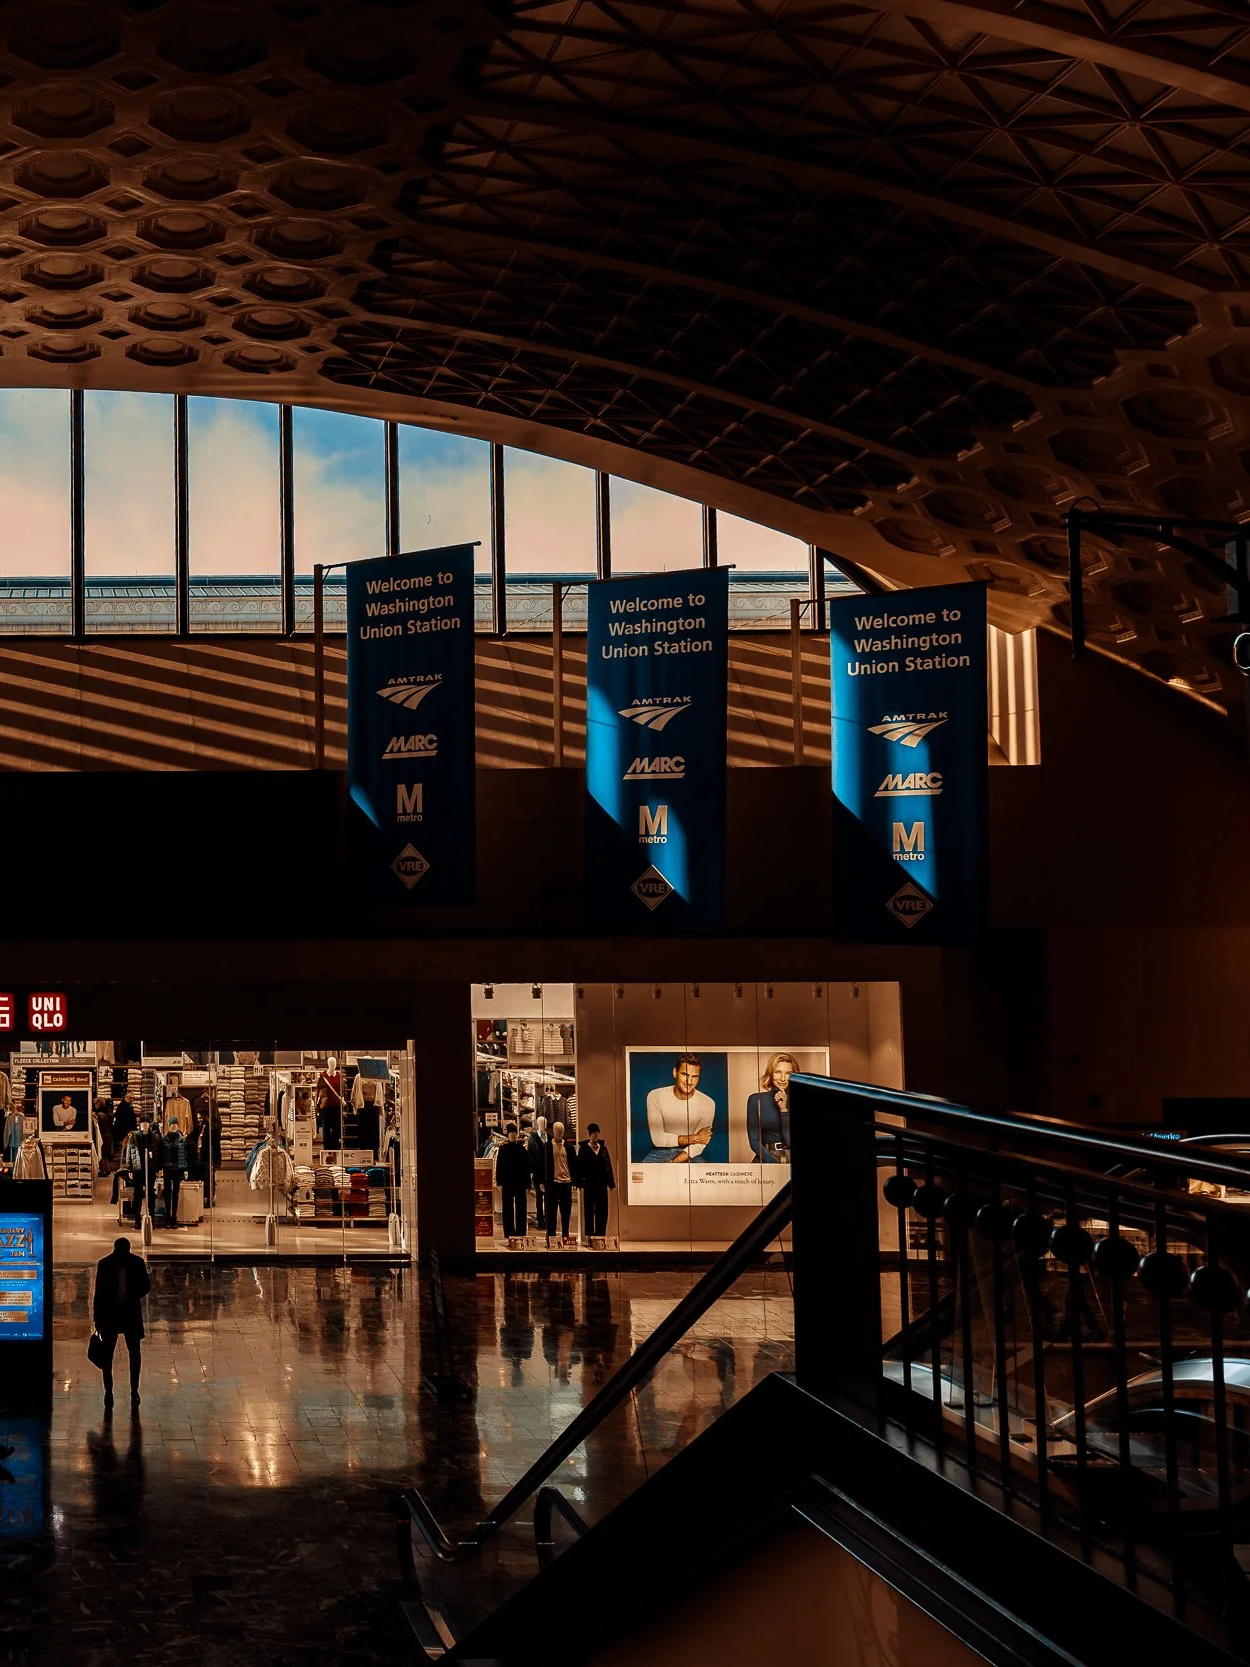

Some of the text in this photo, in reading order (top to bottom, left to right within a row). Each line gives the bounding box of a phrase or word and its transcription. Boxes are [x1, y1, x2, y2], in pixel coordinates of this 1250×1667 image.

[366, 571, 454, 595] Welcome to
[365, 595, 454, 617] Washington
[609, 592, 706, 614] Welcome to
[359, 616, 461, 640] Union Station
[608, 617, 706, 637] Washington
[854, 608, 962, 631] Welcome to
[601, 637, 713, 659] Union Station
[853, 632, 962, 653] Washington
[847, 653, 971, 676] Union Station
[387, 674, 443, 685] AMTRAK
[631, 695, 693, 706] AMTRAK
[881, 711, 949, 722] AMTRAK
[385, 733, 438, 753] MARC
[627, 755, 686, 774] MARC
[878, 772, 943, 791] MARC
[396, 783, 423, 814] M
[396, 813, 423, 822] metro
[638, 805, 668, 835] M
[638, 835, 668, 844] metro
[892, 822, 925, 852] M
[893, 852, 925, 861] metro
[399, 861, 422, 872] VRE
[639, 883, 666, 894] VRE
[894, 899, 924, 911] VRE
[32, 997, 60, 1011] UNI
[32, 1013, 63, 1029] QLO
